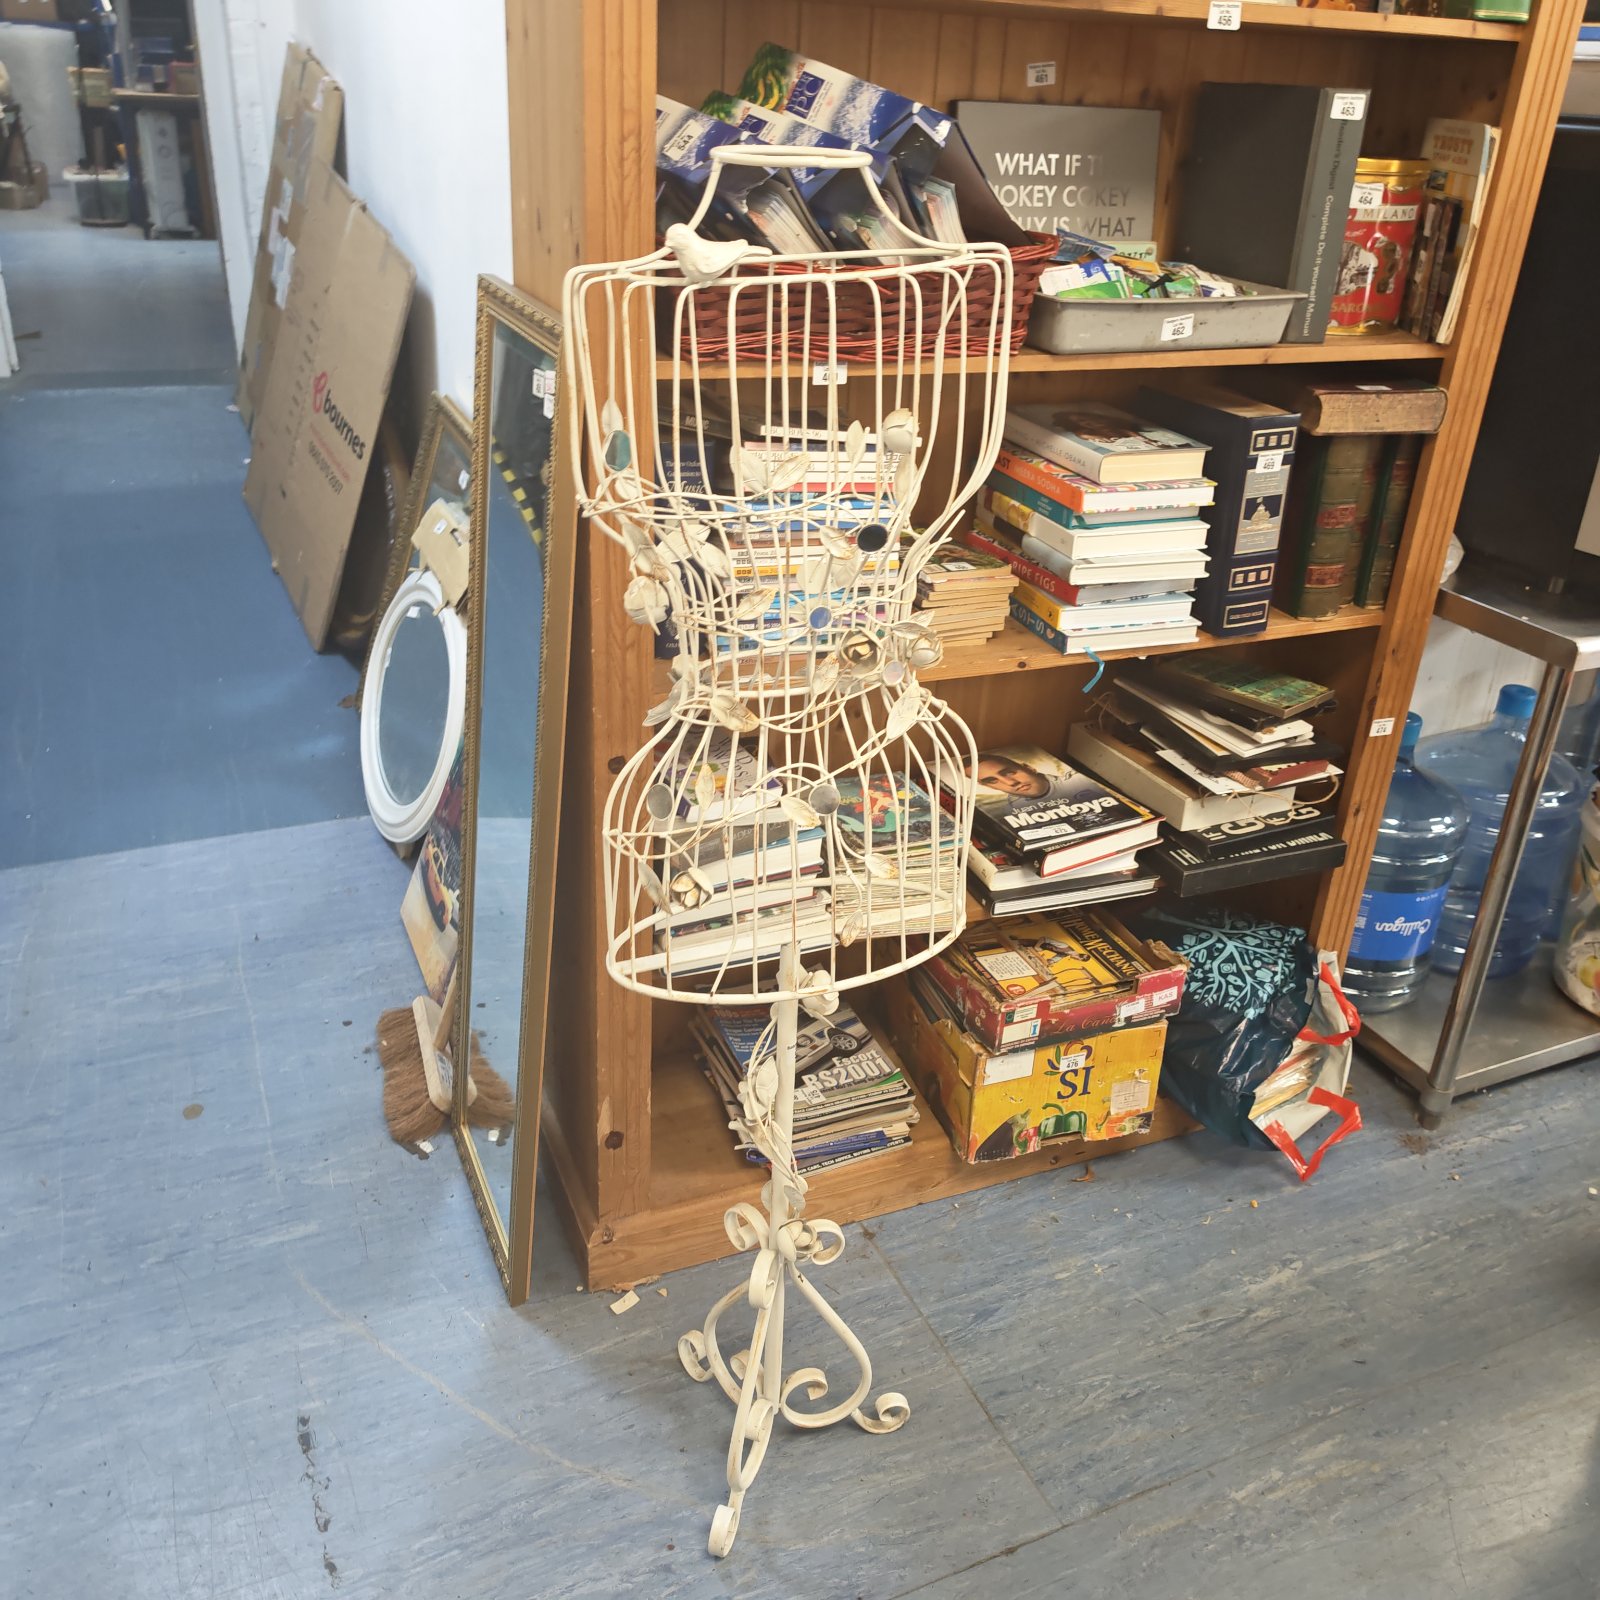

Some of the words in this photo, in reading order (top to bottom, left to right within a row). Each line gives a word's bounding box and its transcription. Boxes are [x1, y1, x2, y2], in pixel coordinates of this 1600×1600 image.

[1217, 15, 1232, 26] 456
[1340, 106, 1356, 117] 463
[995, 153, 1060, 176] WHAT
[1064, 154, 1082, 176] IF
[1358, 196, 1373, 206] 464
[1319, 195, 1334, 240] Complete
[1302, 303, 1316, 337] Manual
[1171, 326, 1186, 337] 462
[323, 388, 366, 460] bournes
[1064, 452, 1087, 468] OBAMA
[1037, 475, 1061, 496] SODHA
[1012, 561, 1033, 579] RIPE
[1034, 572, 1056, 592] FIGS
[1011, 602, 1045, 635] ASTS
[1004, 796, 1119, 829] Montoya
[1012, 804, 1037, 815] Juan
[1038, 797, 1070, 810] Pablo
[1375, 917, 1431, 936] Culligan
[1081, 938, 1137, 976] MECHANIC
[1157, 990, 1174, 1001] KAS
[1053, 1022, 1075, 1033] La
[831, 1049, 881, 1068] Escort
[1066, 1061, 1079, 1069] 476
[801, 1057, 892, 1090] RS2001
[1056, 1065, 1095, 1100] SI
[821, 1159, 835, 1167] TECH
